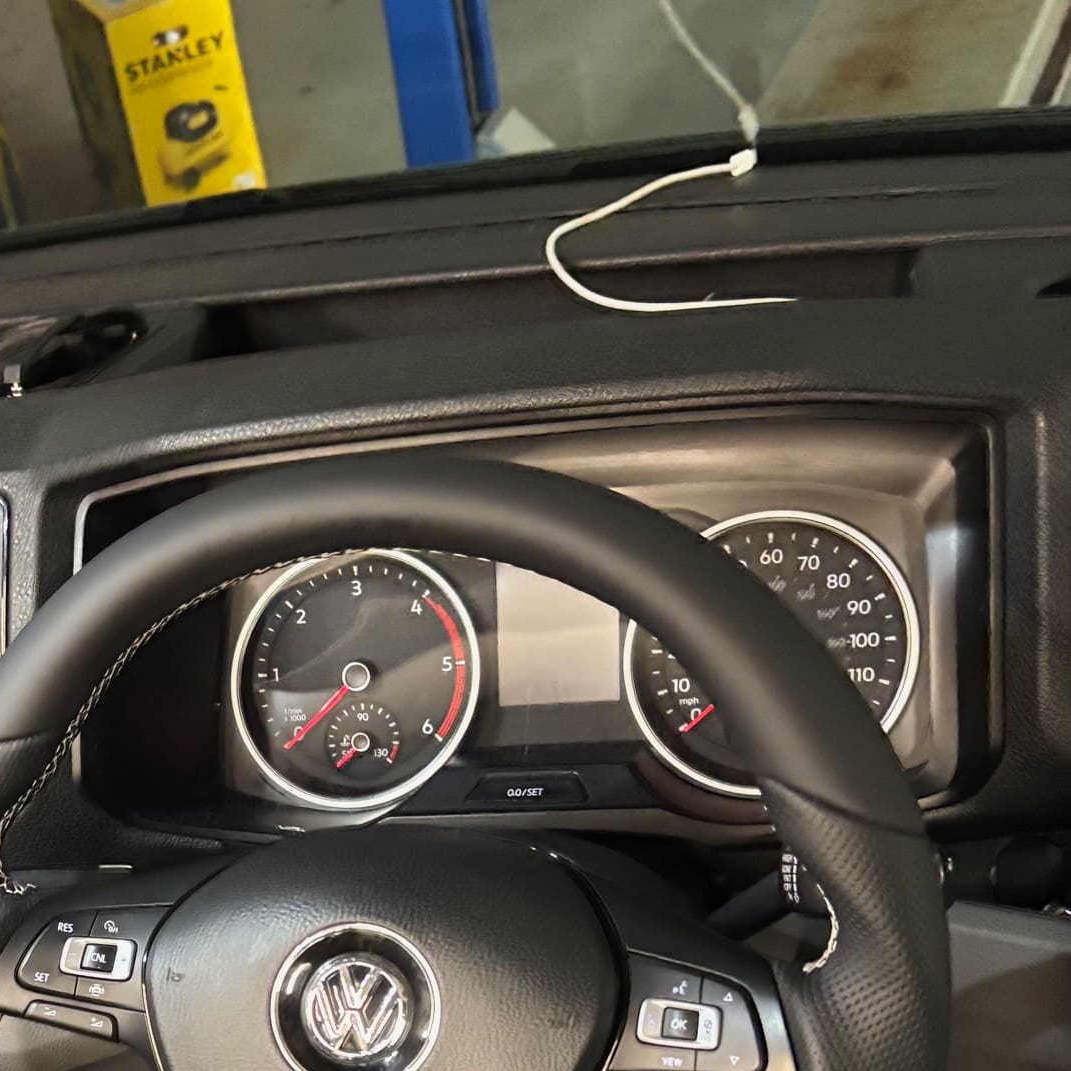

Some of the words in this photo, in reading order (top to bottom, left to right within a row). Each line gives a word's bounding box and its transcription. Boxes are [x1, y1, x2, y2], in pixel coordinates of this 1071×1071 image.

[125, 30, 225, 82] STANLEY
[760, 549, 783, 564] 60
[798, 555, 820, 571] 70
[351, 580, 362, 596] 3
[826, 573, 850, 589] 80
[410, 599, 422, 615] 4
[847, 600, 871, 615] 90
[295, 608, 307, 624] 2
[850, 632, 879, 648] 100
[441, 656, 452, 671] 5
[272, 668, 279, 682] 1
[847, 667, 875, 682] 110
[672, 678, 690, 693] 10
[679, 697, 699, 706] mph
[289, 714, 306, 722] 1000
[357, 713, 369, 722] 90
[422, 718, 434, 734] 6
[374, 748, 389, 757] 130
[57, 922, 74, 933] RES
[91, 952, 106, 964] CNL
[34, 972, 50, 983] SET
[670, 1018, 688, 1030] OK
[662, 1057, 683, 1067] VIEW
